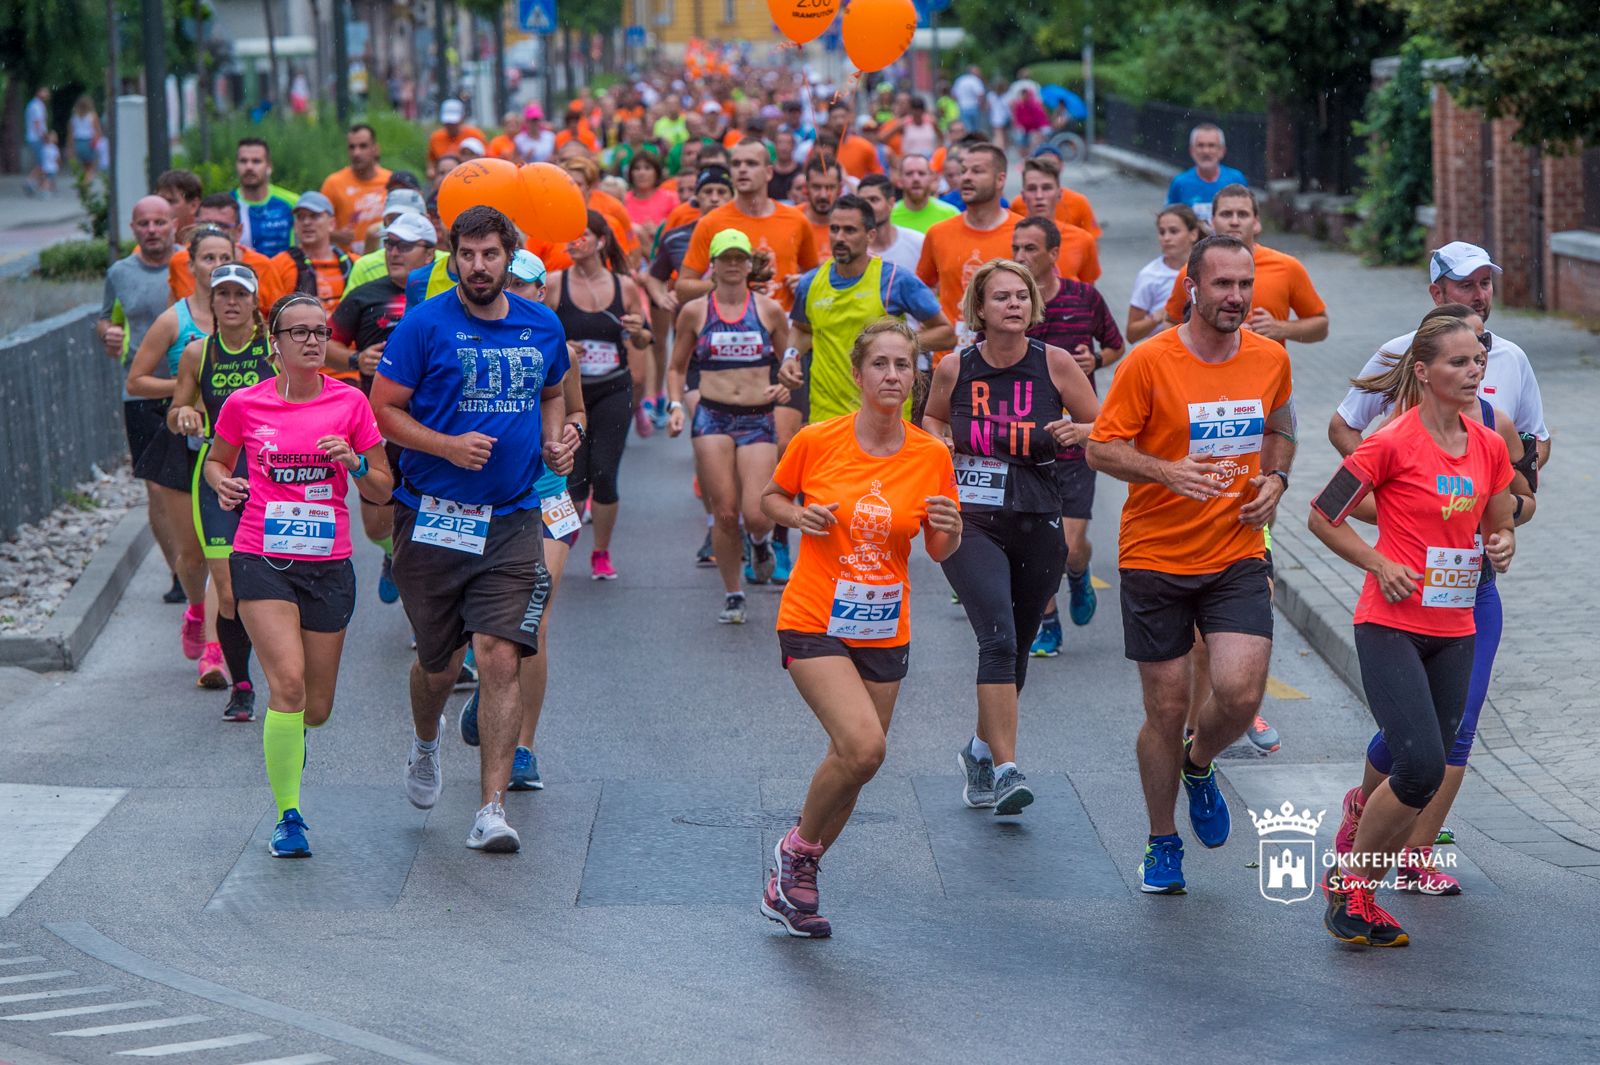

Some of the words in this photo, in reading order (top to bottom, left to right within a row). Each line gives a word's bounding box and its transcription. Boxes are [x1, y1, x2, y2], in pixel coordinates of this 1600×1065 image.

[456, 346, 544, 399] UB
[1199, 419, 1251, 439] 7167
[269, 453, 311, 464] PERFECT
[273, 468, 296, 483] TO
[296, 467, 328, 482] RUN
[1436, 474, 1474, 497] RUN
[276, 520, 321, 537] 7311
[425, 513, 477, 535] 7312
[838, 601, 897, 621] 7257
